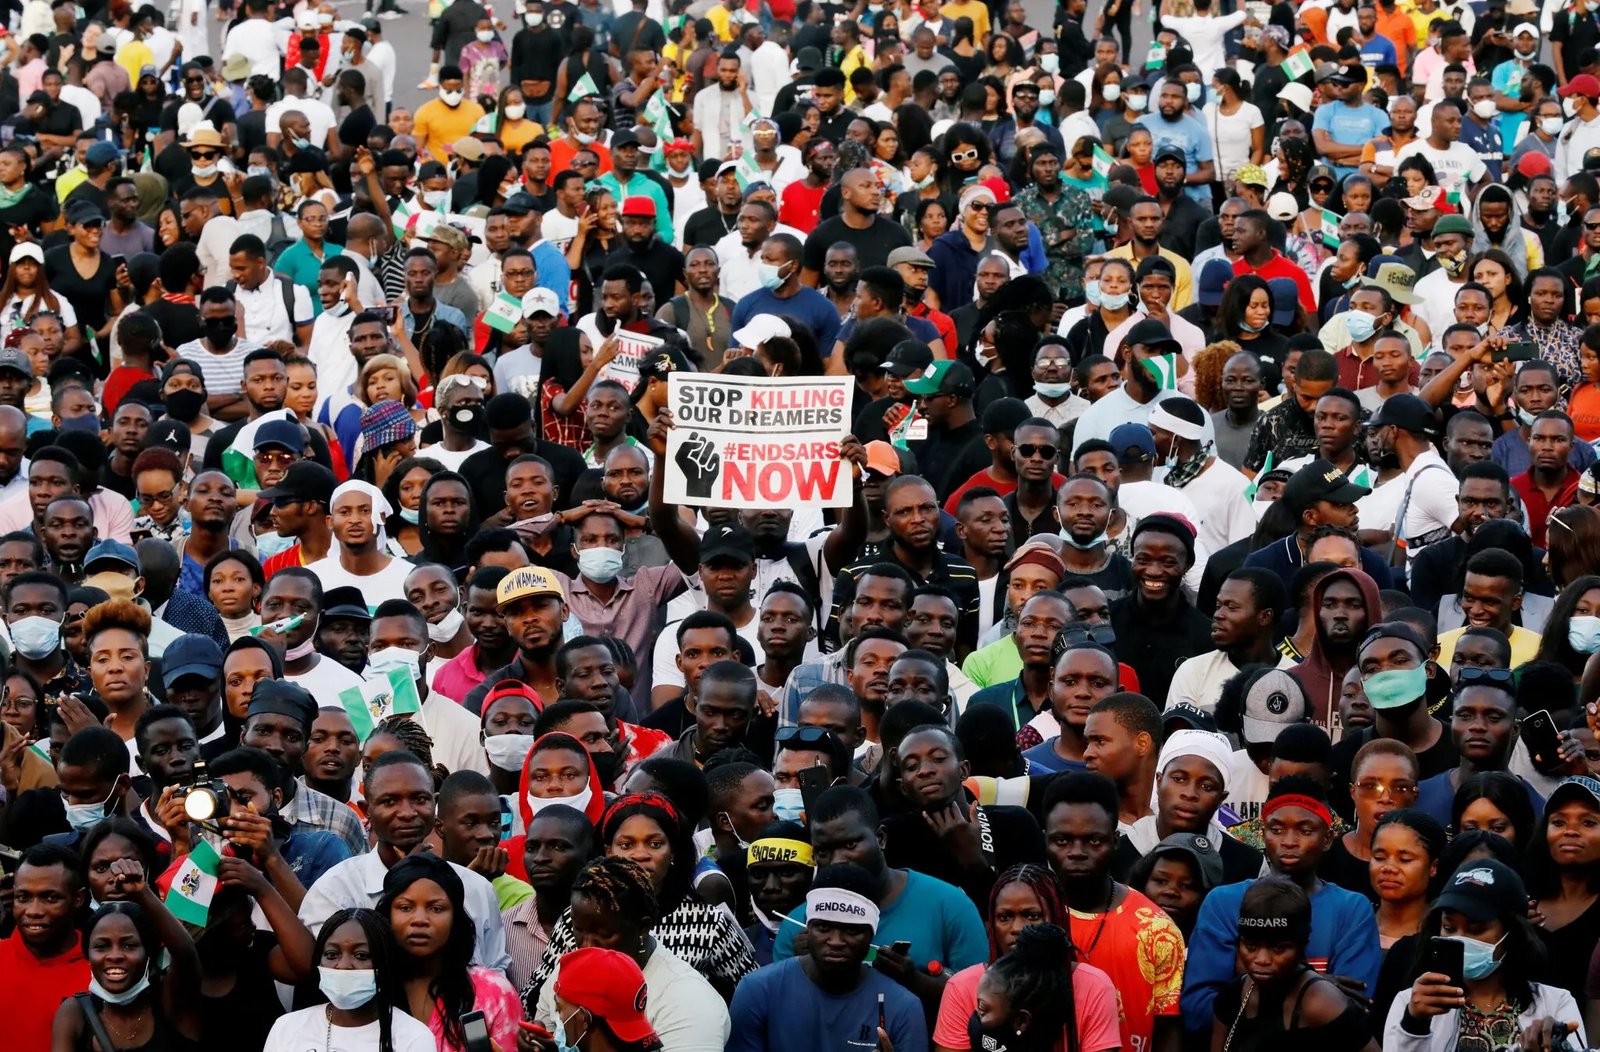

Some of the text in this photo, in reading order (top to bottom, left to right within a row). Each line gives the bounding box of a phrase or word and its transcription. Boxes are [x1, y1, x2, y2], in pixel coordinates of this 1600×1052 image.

[678, 385, 845, 409] STOP KILLING
[678, 405, 842, 426] OUR DREAMERS
[722, 442, 840, 461] #ENDSARS
[722, 461, 841, 502] NOW
[815, 902, 867, 917] #ENDSARS
